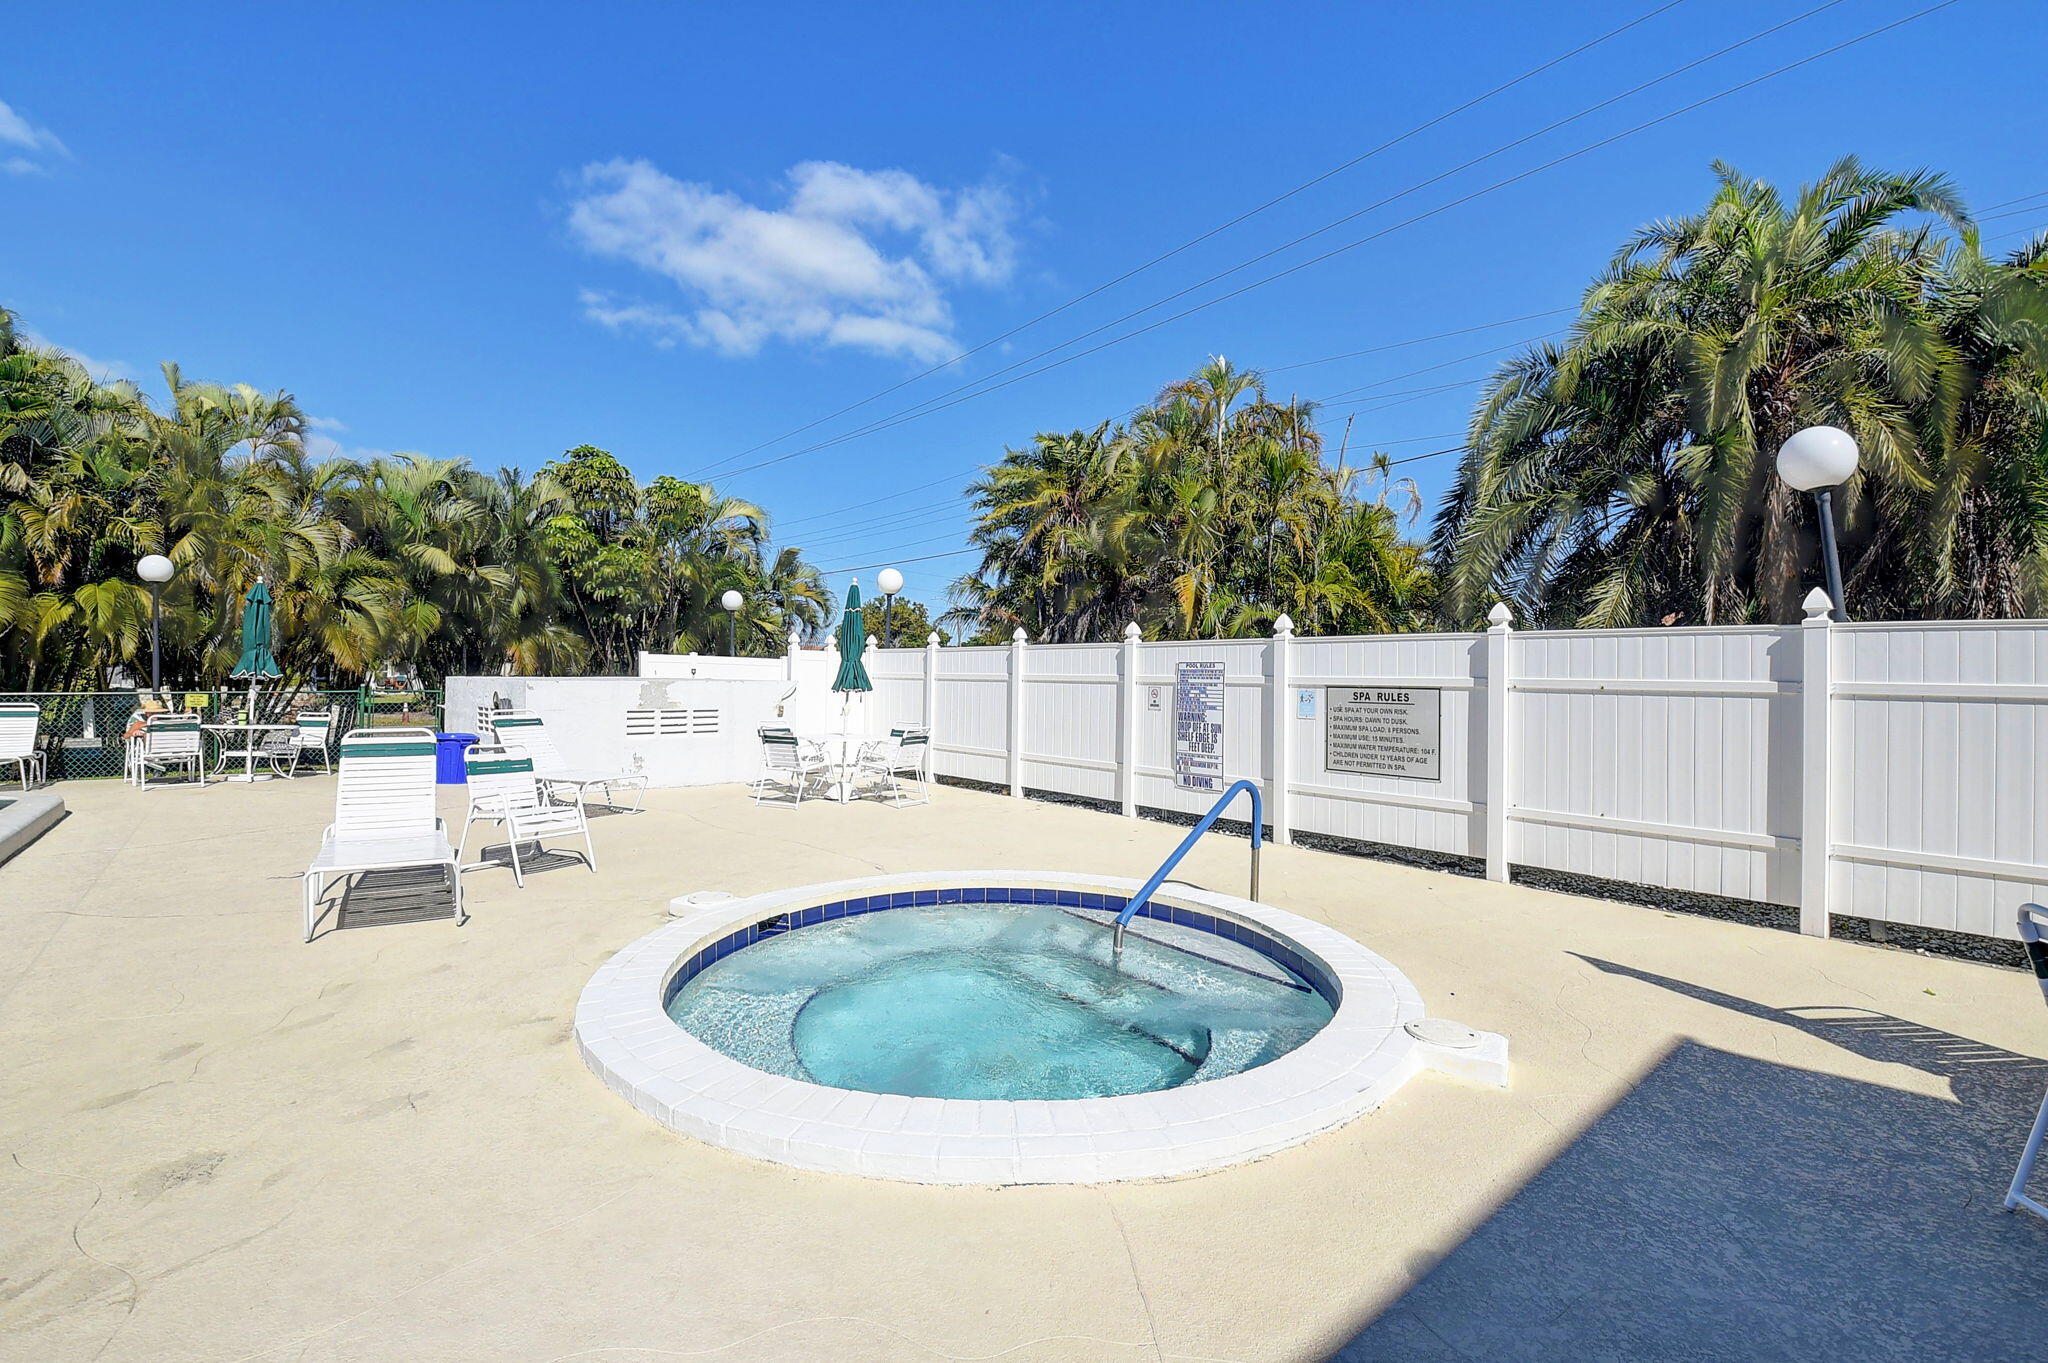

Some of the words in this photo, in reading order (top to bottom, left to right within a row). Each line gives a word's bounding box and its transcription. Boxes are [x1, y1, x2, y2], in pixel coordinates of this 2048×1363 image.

[1353, 692, 1370, 700] SPA
[1377, 692, 1410, 702] RULES
[1178, 712, 1207, 722] WARNING:
[1178, 722, 1191, 731] DROP
[1192, 722, 1201, 732] OFF
[1202, 723, 1209, 733] AT
[1210, 723, 1222, 734] SUN
[1178, 731, 1194, 741] SHELF
[1195, 732, 1210, 743] EDGE
[1211, 734, 1218, 744] IS
[1188, 742, 1200, 752] FEET
[1201, 742, 1215, 754] DEEP.
[1356, 761, 1386, 770] PERMITTED
[1183, 775, 1191, 785] NO
[1192, 776, 1212, 788] DIVING
